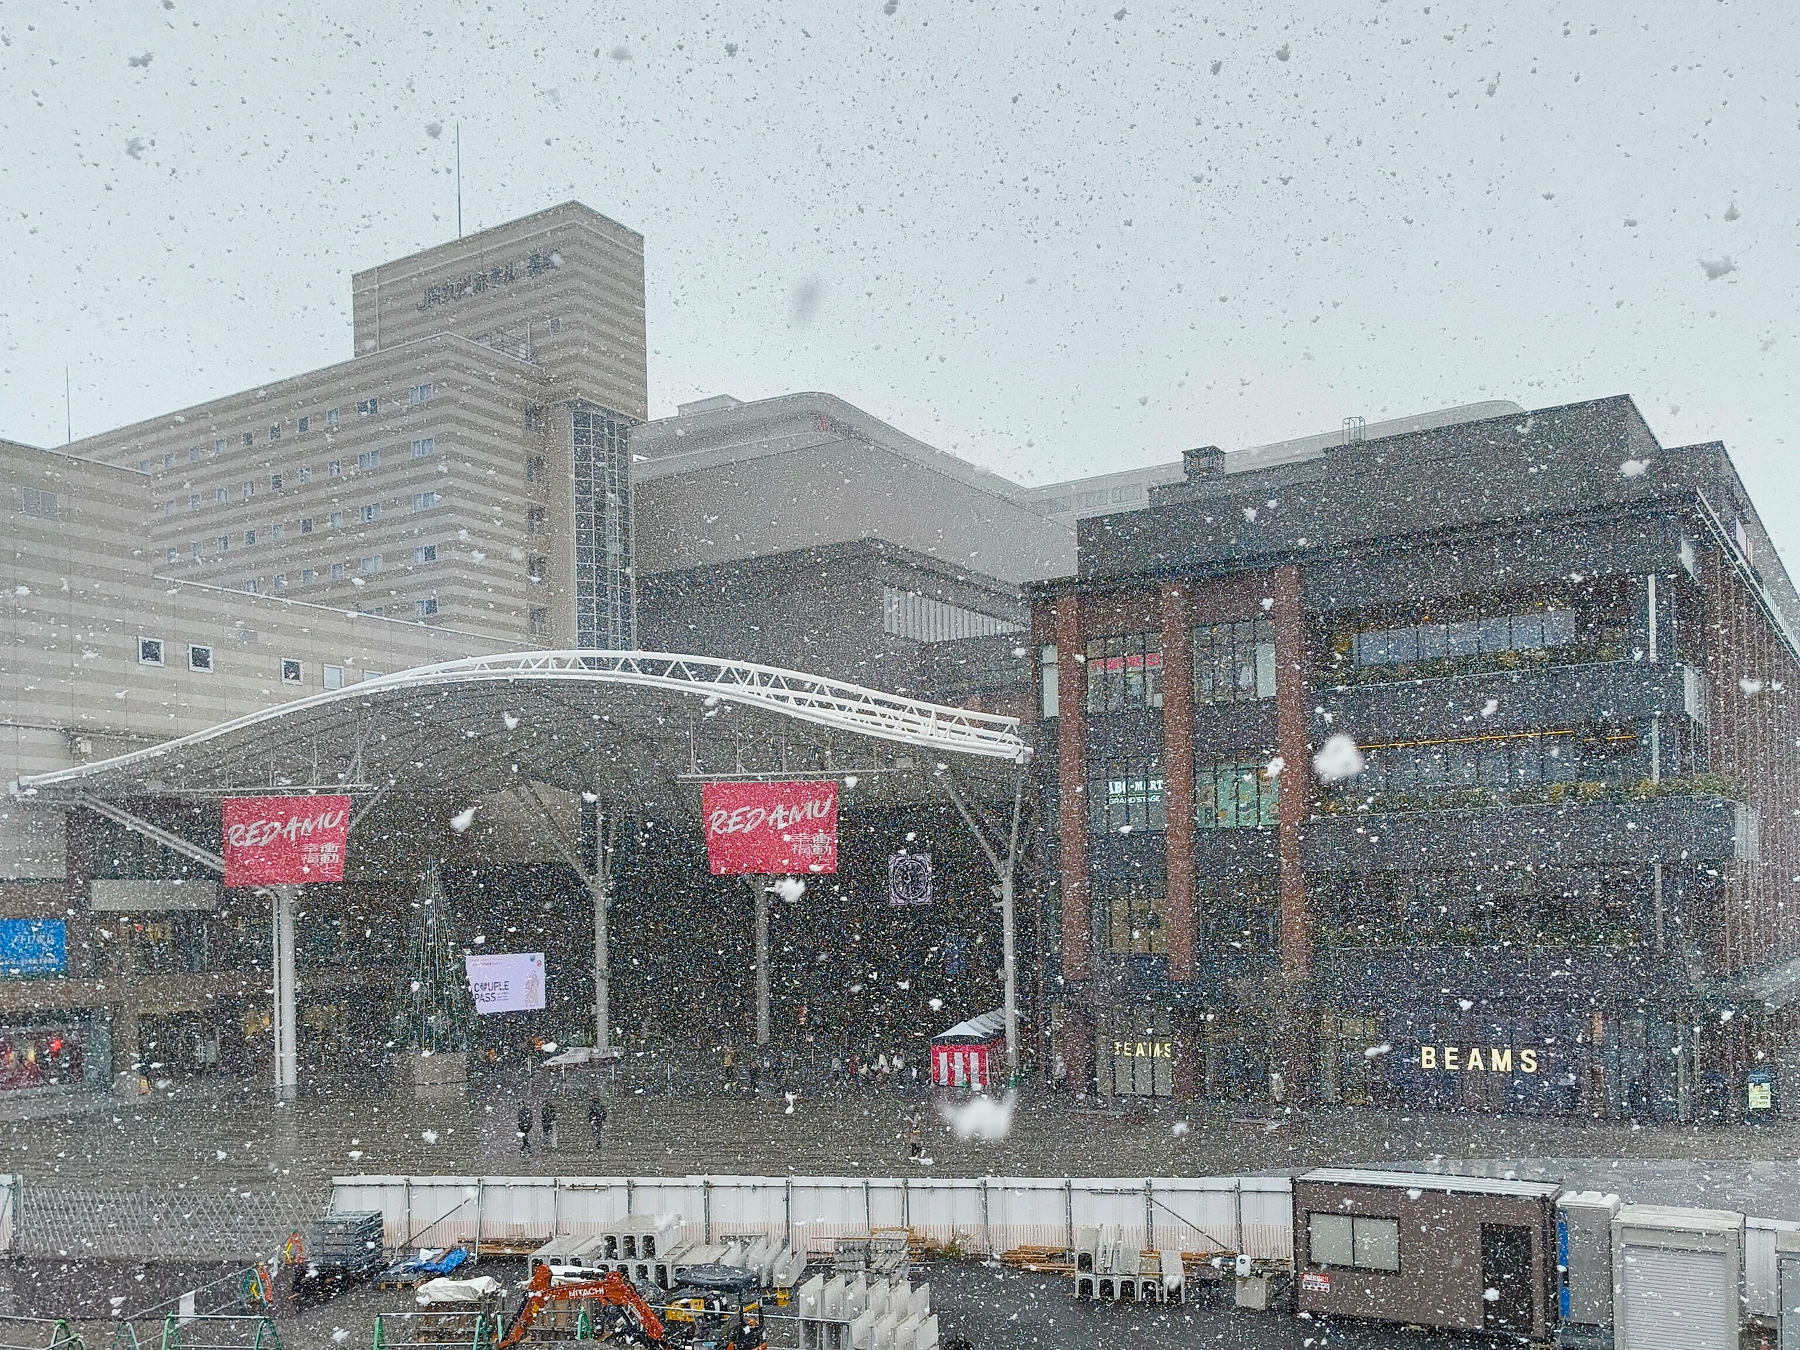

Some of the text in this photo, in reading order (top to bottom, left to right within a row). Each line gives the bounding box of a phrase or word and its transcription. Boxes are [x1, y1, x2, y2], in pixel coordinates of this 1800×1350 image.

[474, 992, 497, 1003] PASS
[1421, 1046, 1538, 1073] BEAMS
[568, 1286, 605, 1298] HITACHI
